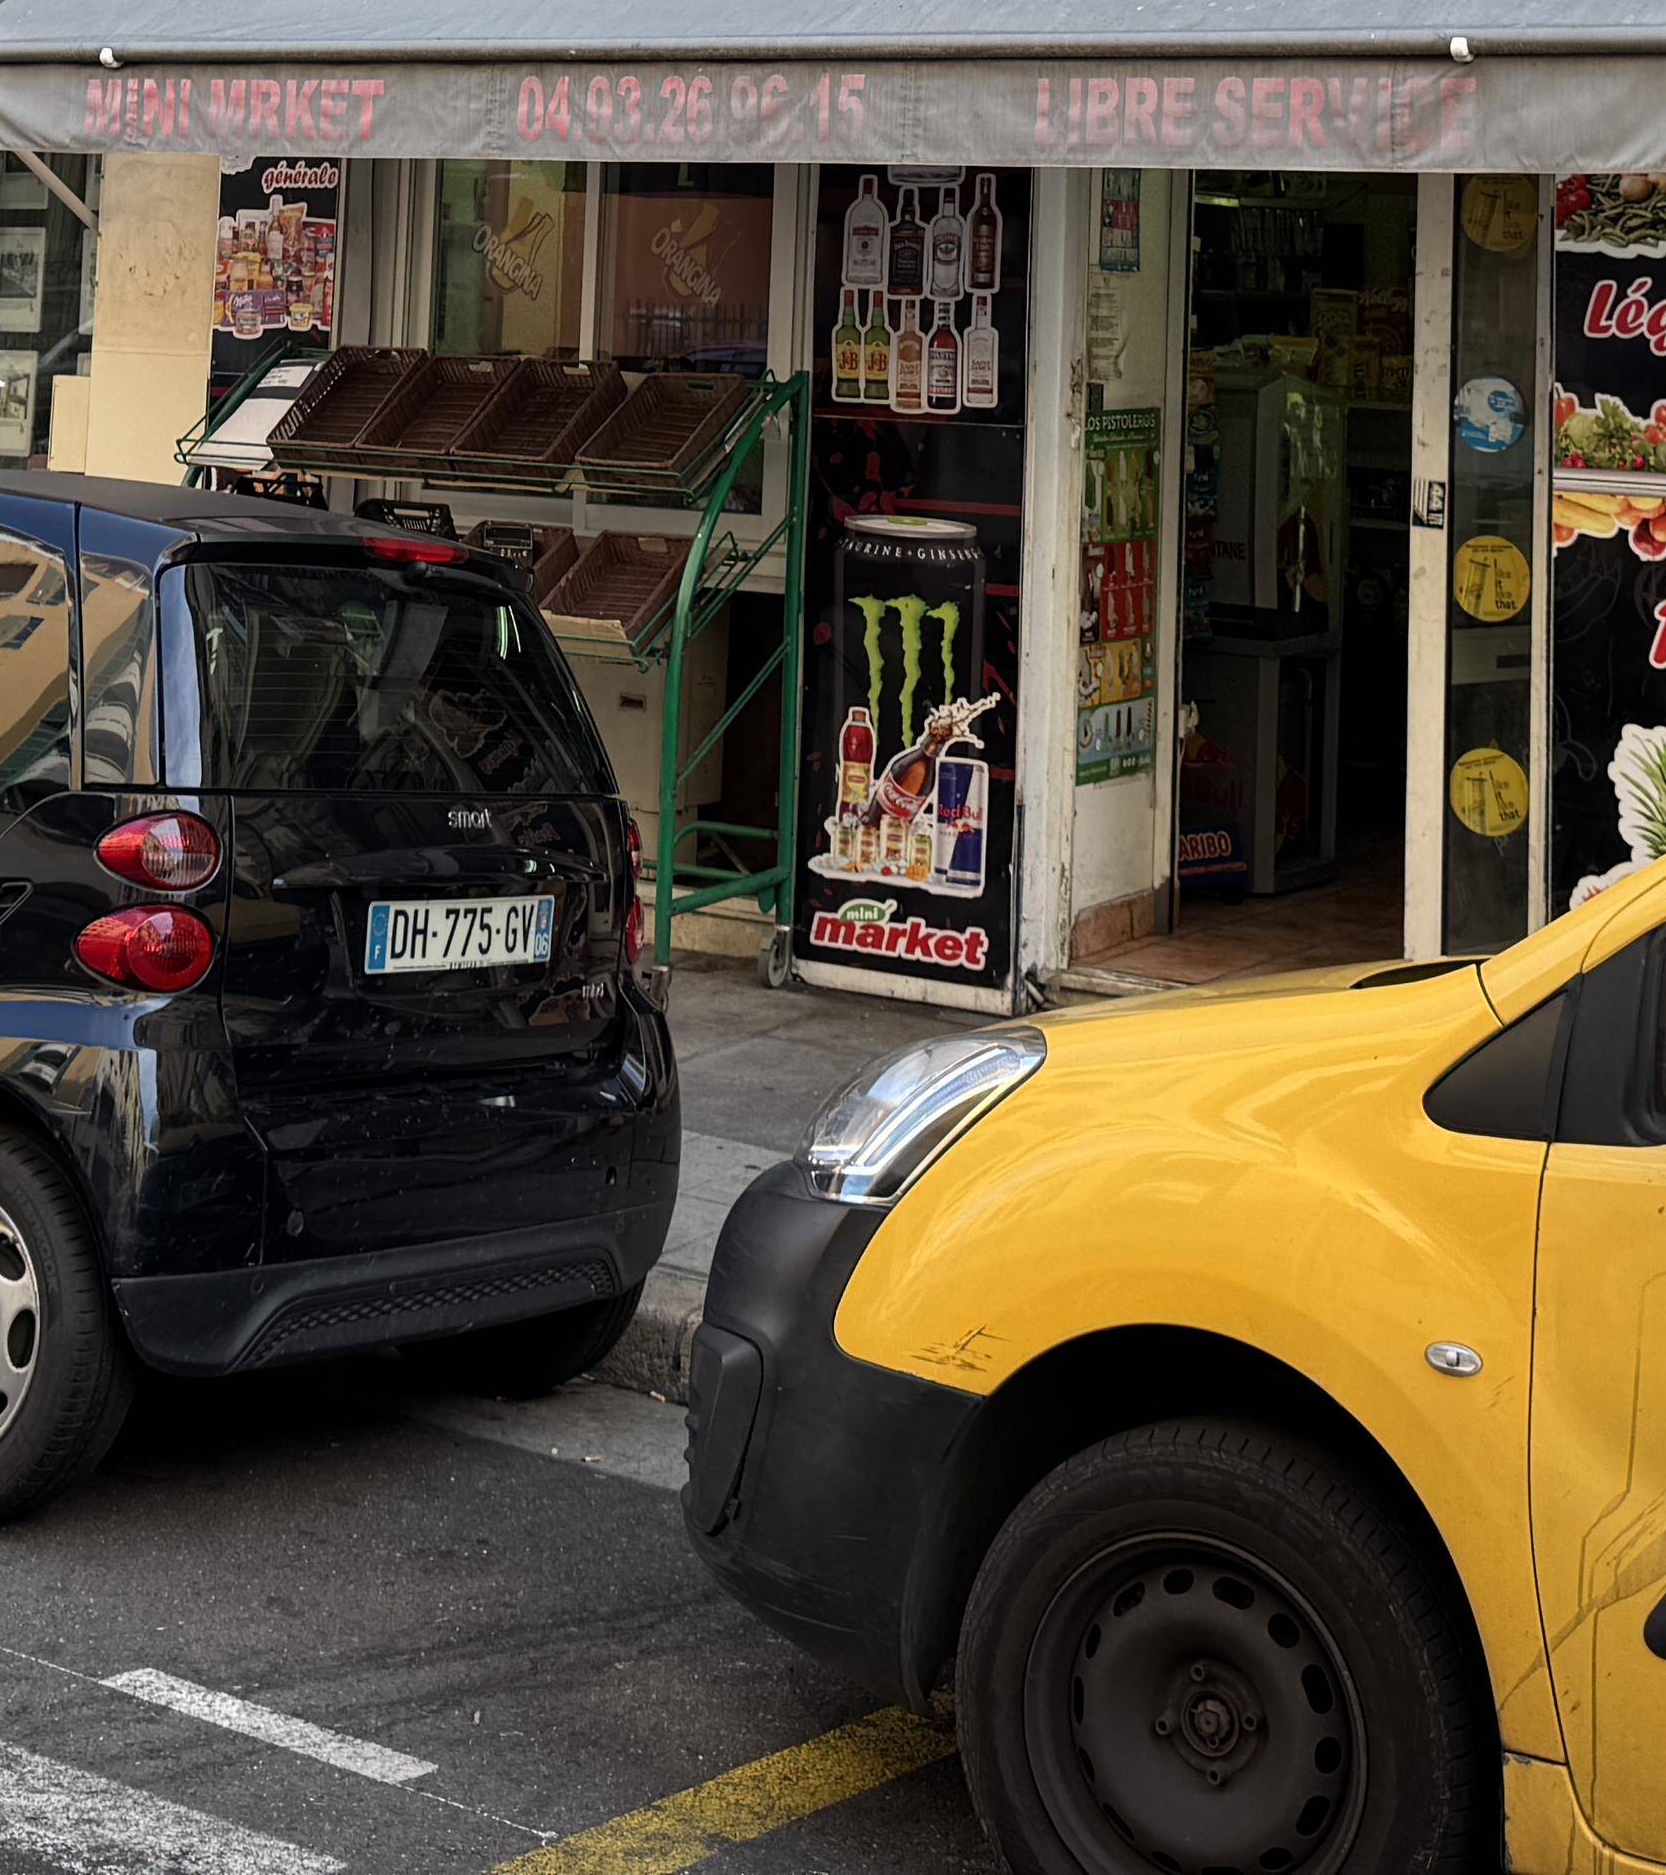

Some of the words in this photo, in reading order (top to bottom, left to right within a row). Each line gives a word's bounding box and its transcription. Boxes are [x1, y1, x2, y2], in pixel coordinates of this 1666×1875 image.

[84, 78, 192, 138] MINI
[1034, 76, 1197, 147] LIBRE
[1214, 76, 1477, 152] SERVICE
[262, 160, 339, 194] générale
[471, 223, 543, 301] ORANGINA
[650, 227, 722, 309] ORANGINA
[1102, 413, 1156, 431] PISTOLEROS
[448, 808, 493, 829] smart
[390, 904, 536, 960] DH-775-GV
[534, 933, 550, 957] 06
[812, 914, 986, 968] market
[846, 908, 879, 921] mini
